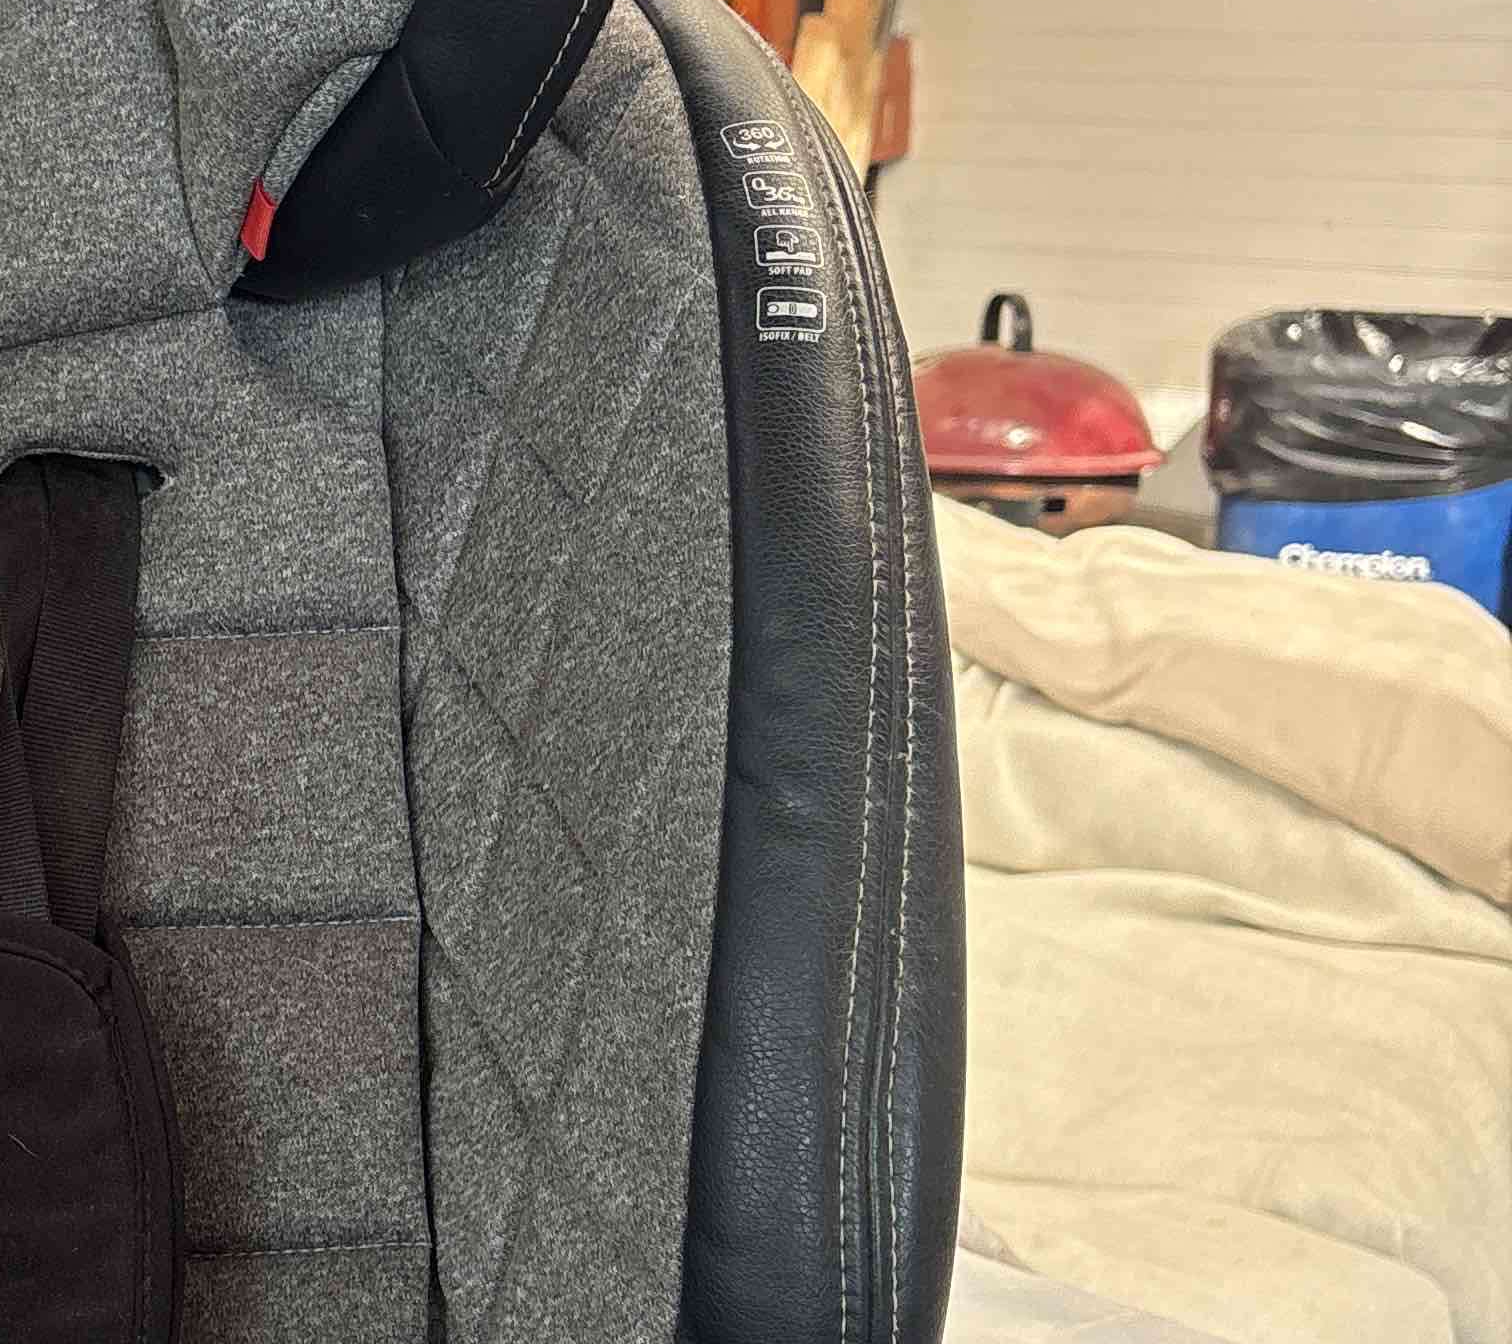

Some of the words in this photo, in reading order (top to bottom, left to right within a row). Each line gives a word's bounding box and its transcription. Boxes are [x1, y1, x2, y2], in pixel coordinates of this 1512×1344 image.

[738, 127, 775, 141] 360
[768, 266, 792, 276] SOFT
[792, 266, 813, 277] PAD
[759, 331, 791, 342] ISOFIX
[797, 332, 821, 343] BELT
